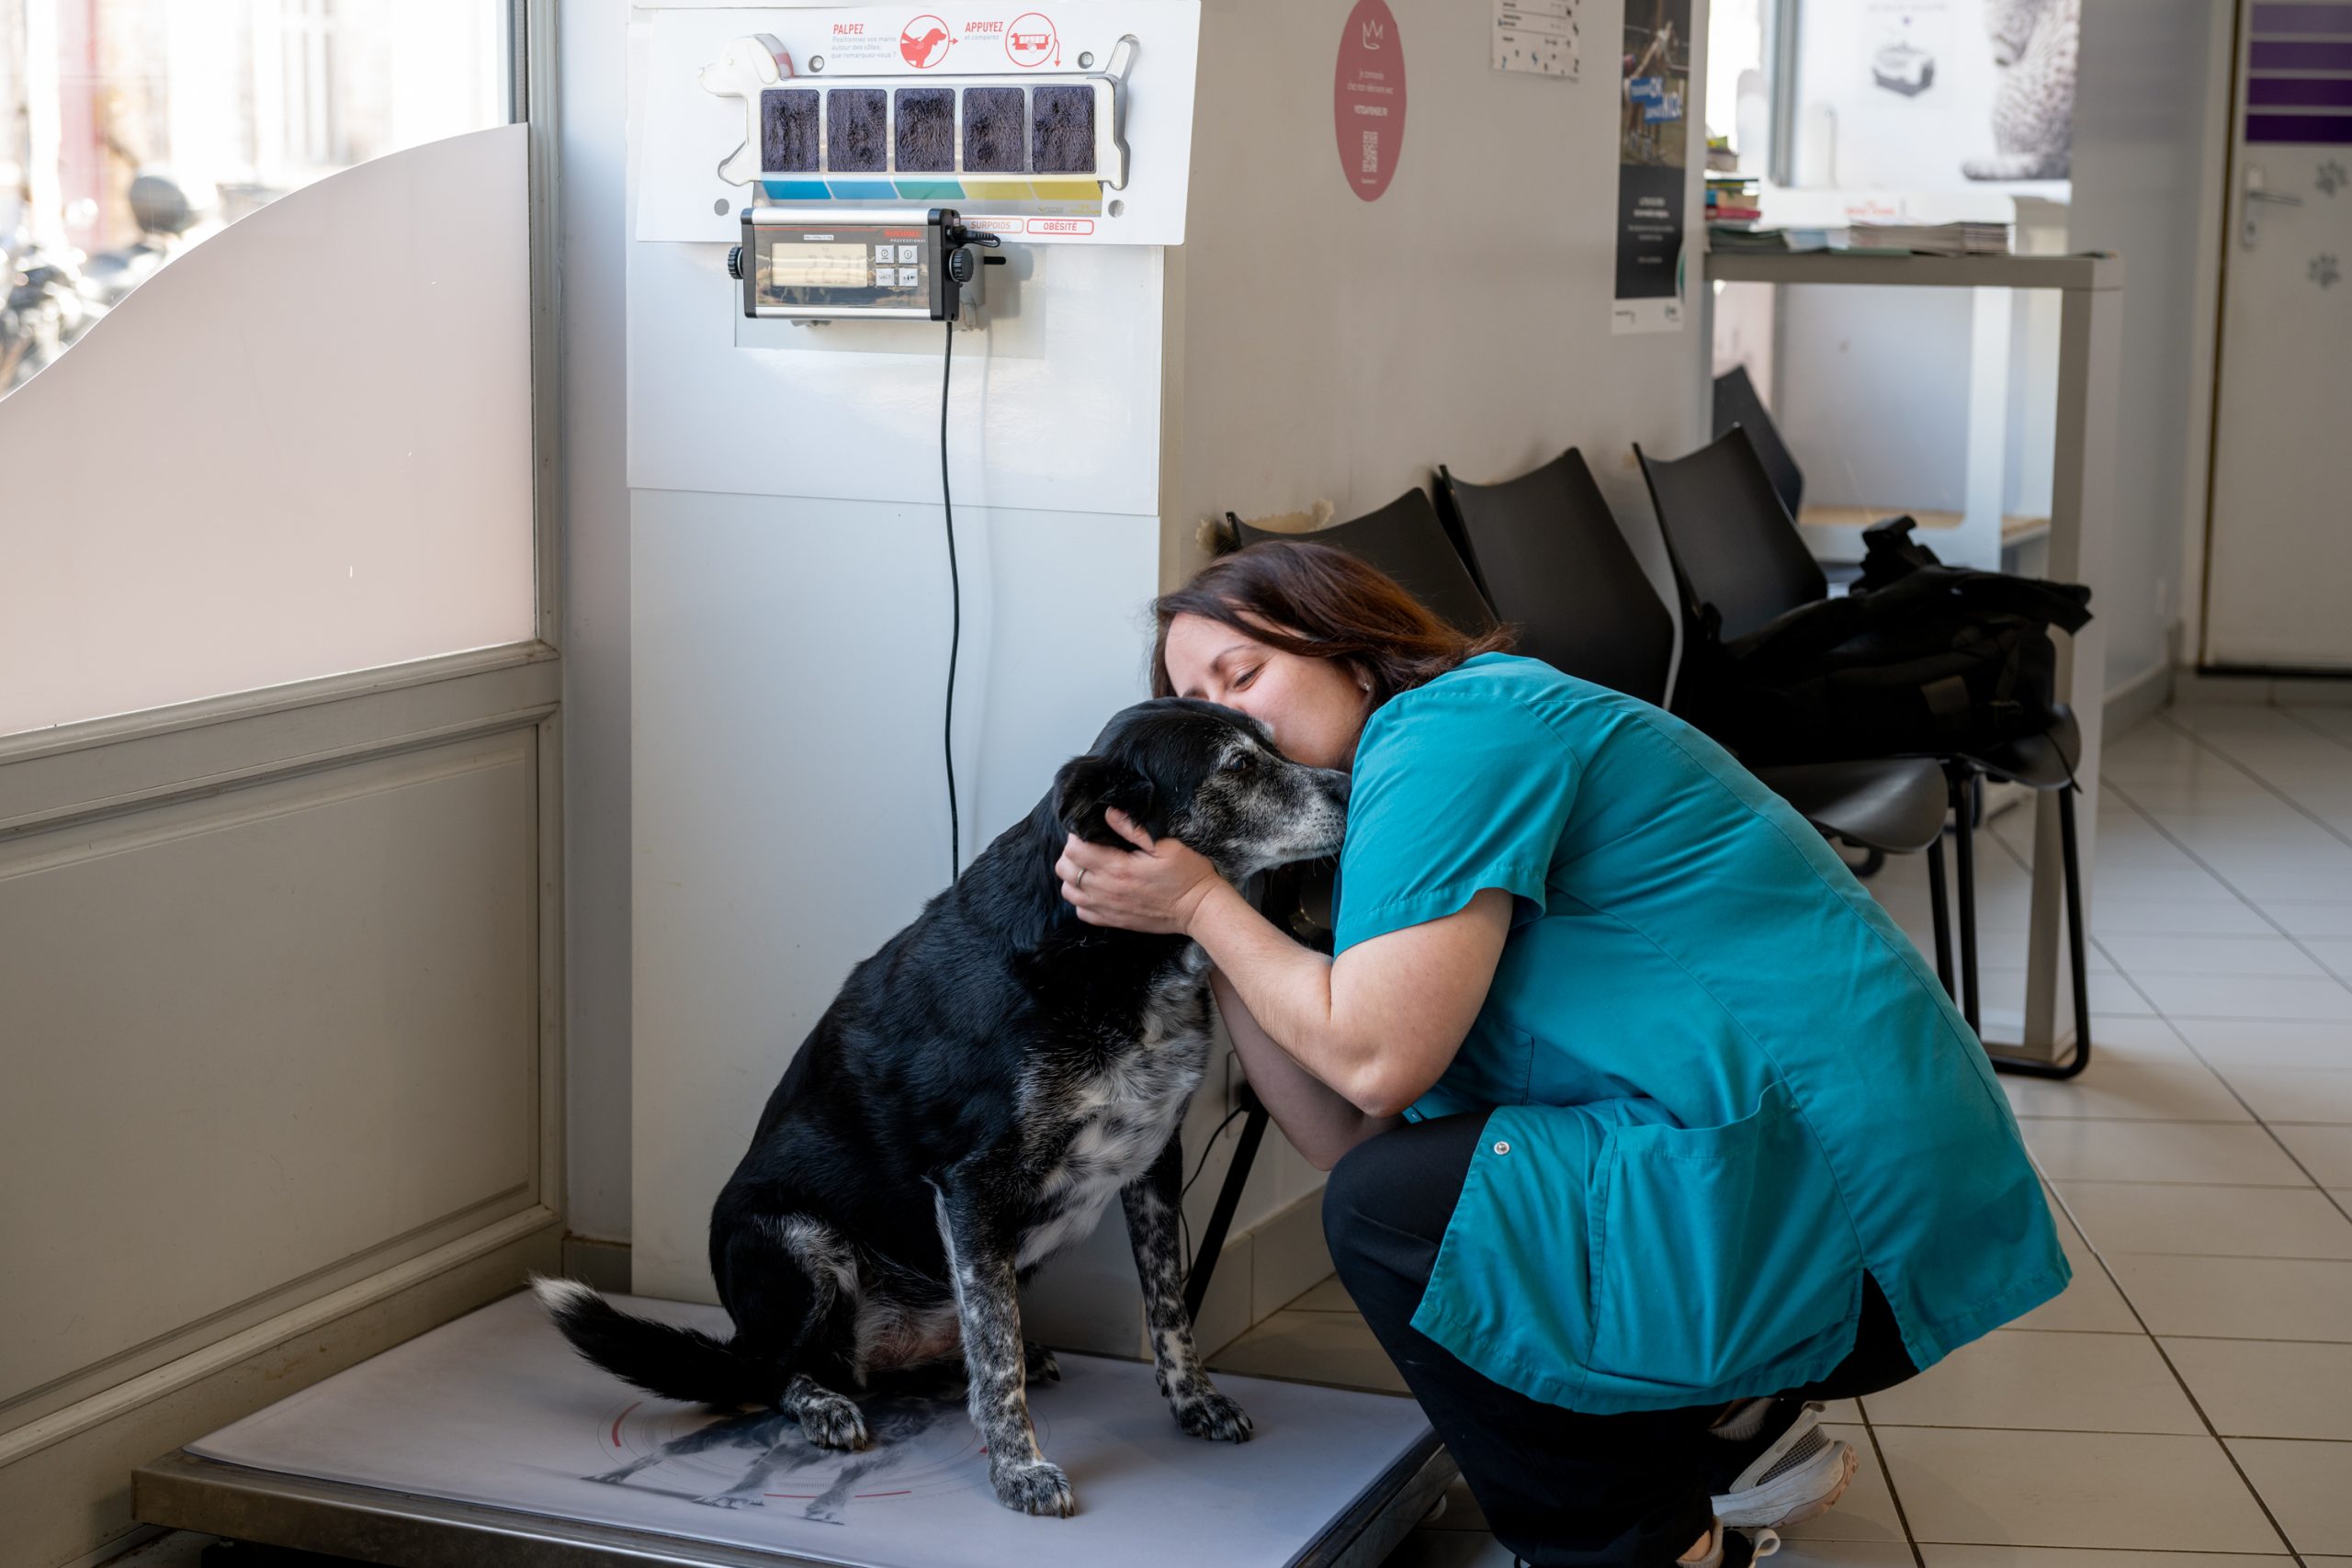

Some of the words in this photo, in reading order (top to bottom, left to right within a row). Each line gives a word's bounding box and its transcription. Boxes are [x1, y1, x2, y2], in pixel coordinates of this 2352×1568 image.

[832, 23, 865, 35] PALPEZ
[965, 21, 1003, 33] APPUYEZ
[842, 51, 891, 60] remarquez-vous
[970, 220, 1011, 230] SURPOIDS
[1043, 220, 1078, 231] OBÉSITÉ
